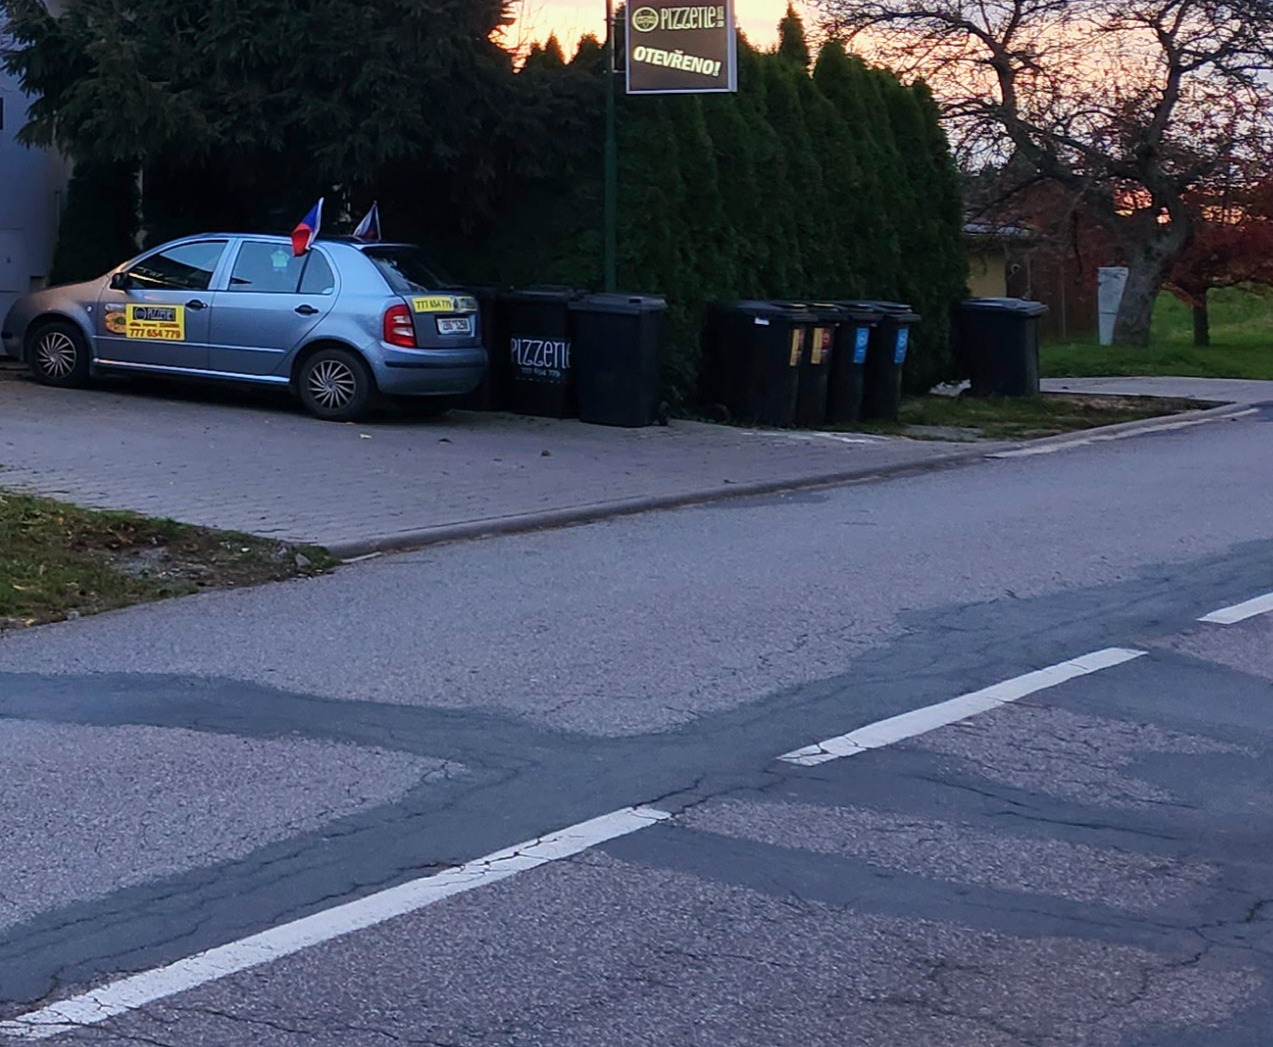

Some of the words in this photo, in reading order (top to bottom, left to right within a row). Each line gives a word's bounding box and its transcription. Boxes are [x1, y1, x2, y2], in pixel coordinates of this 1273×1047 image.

[633, 46, 721, 76] OTEVŘENO!
[129, 328, 145, 337] 777
[147, 329, 163, 337] 654
